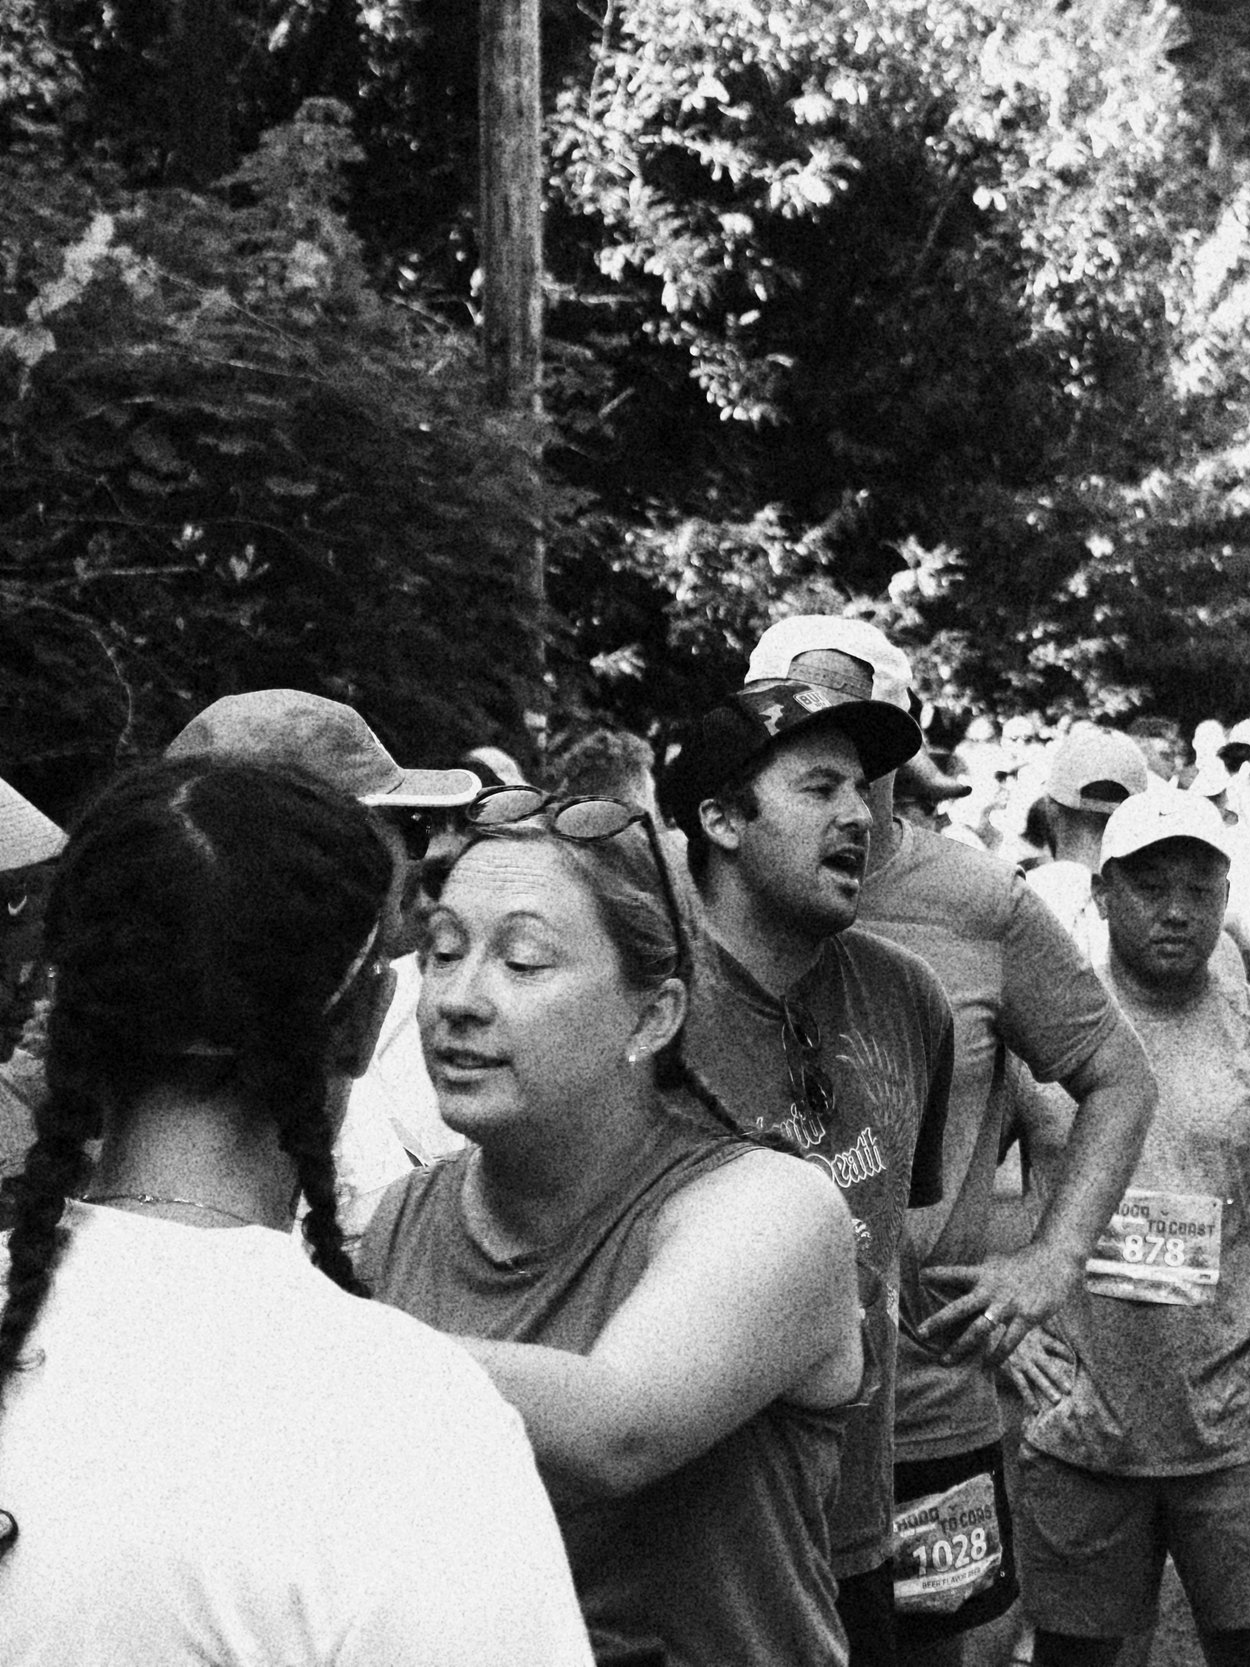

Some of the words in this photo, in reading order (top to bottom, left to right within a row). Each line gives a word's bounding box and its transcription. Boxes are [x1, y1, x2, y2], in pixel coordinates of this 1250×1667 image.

[1119, 1202, 1150, 1218] OOD
[1148, 1219, 1166, 1234] TO
[1168, 1221, 1216, 1238] COAST
[1122, 1234, 1186, 1267] 878
[940, 1516, 958, 1535] TO
[960, 1504, 993, 1528] COAS
[912, 1527, 987, 1576] 1028
